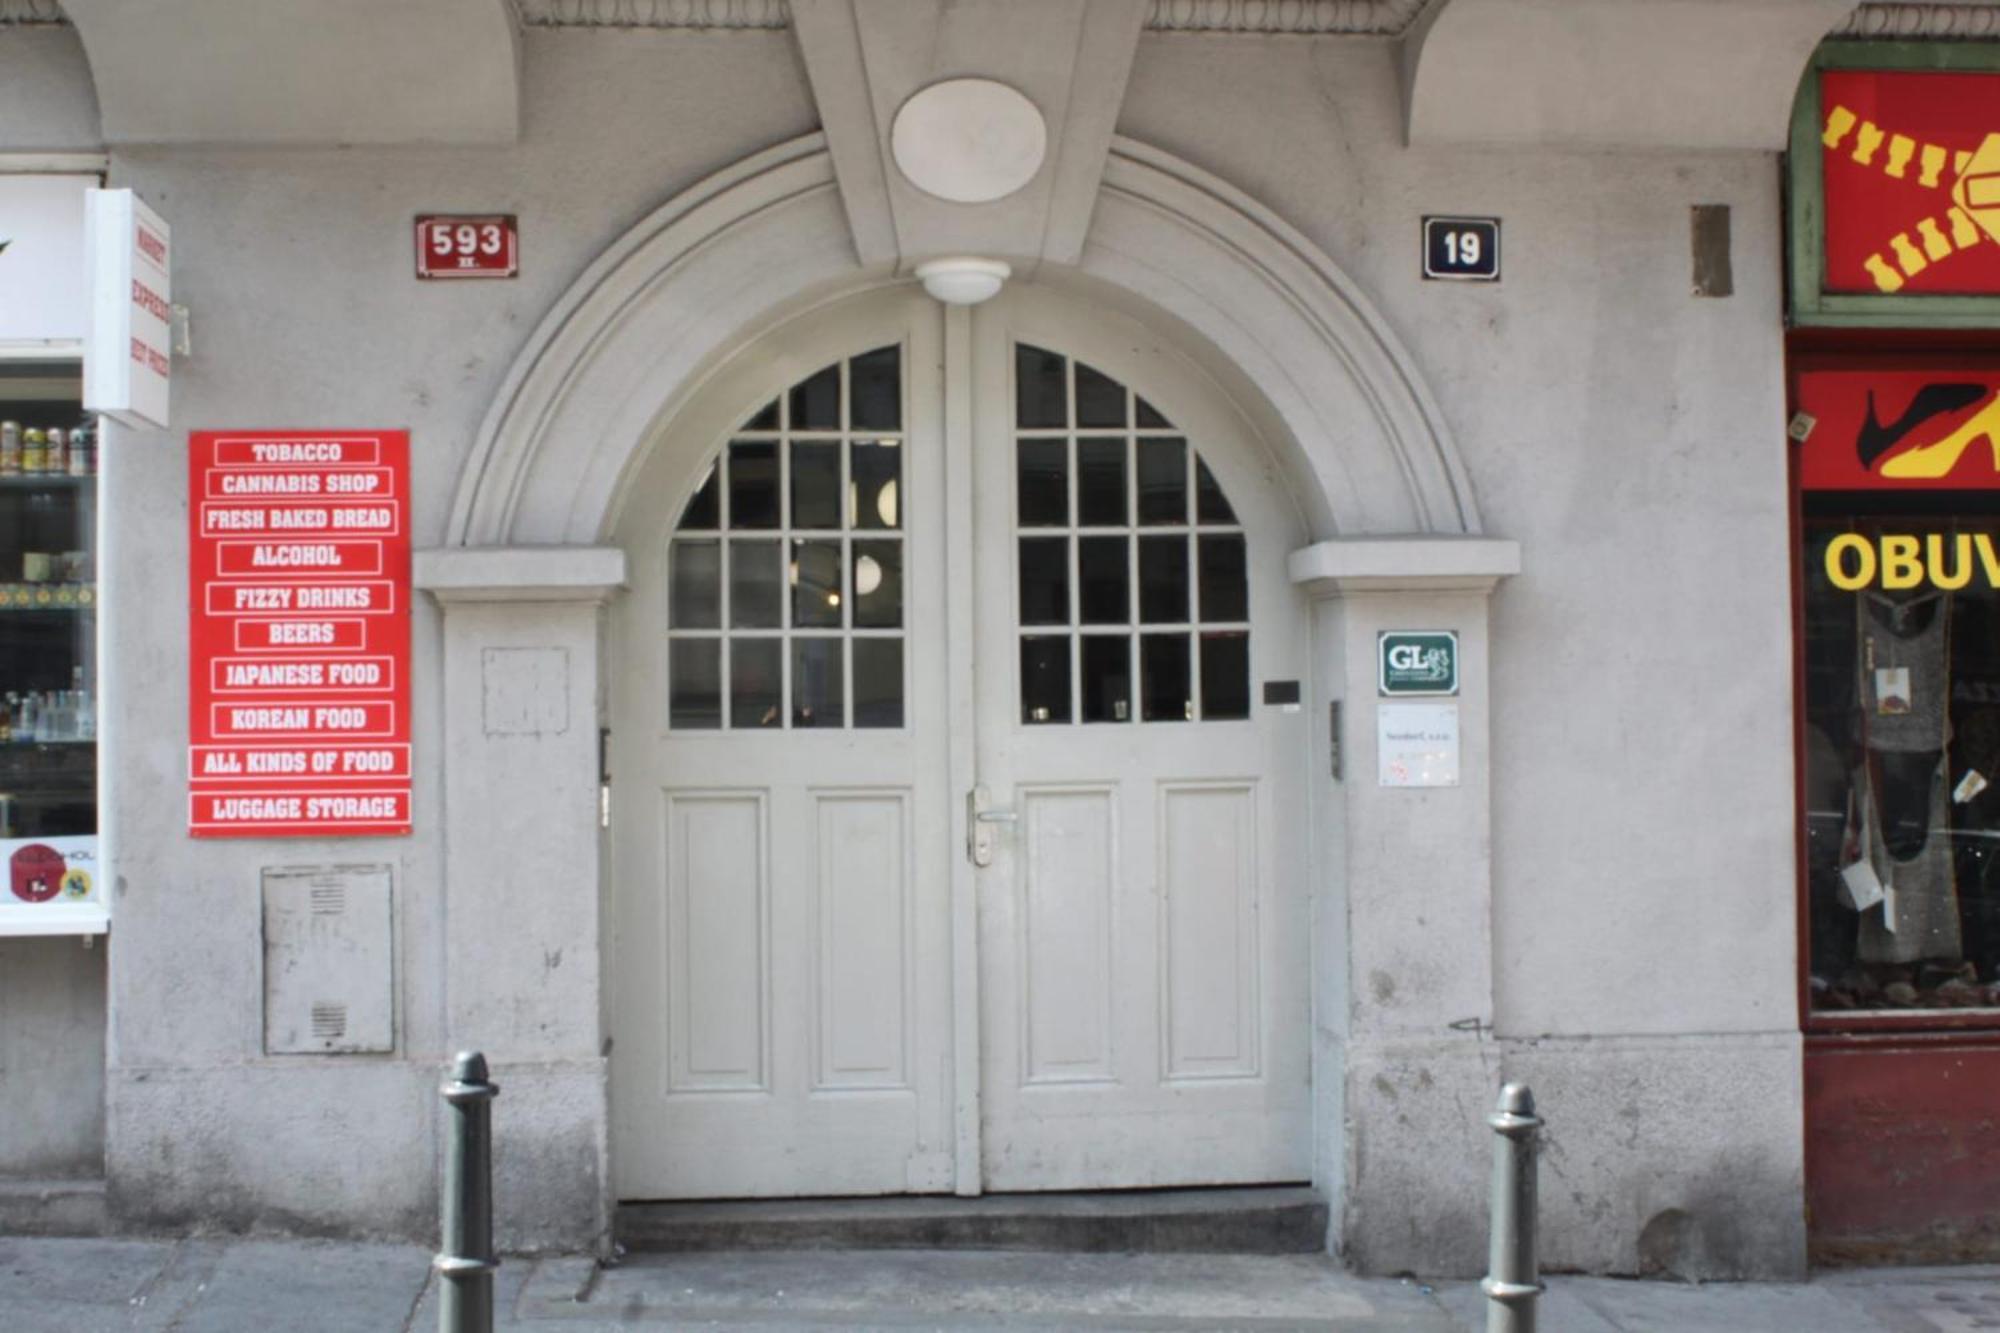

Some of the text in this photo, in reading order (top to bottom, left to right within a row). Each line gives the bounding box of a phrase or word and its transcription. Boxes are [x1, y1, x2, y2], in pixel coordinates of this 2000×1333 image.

[432, 225, 501, 255] 593
[1444, 231, 1480, 265] 19
[252, 444, 342, 461] TOBACCO
[222, 474, 378, 493] CANNABIS SHOP
[207, 509, 391, 529] FRESH BAKED BREAD
[252, 545, 341, 566] ALCOHOL
[235, 587, 370, 608] FIZZY DRINKS
[269, 624, 334, 644] BEERS
[226, 664, 379, 685] JAPANESE FOOD
[231, 708, 366, 729] KOREAN FOOD
[204, 751, 394, 773] ALL KINDS OF FOOD
[212, 798, 396, 819] LUGGAGE STORAGE
